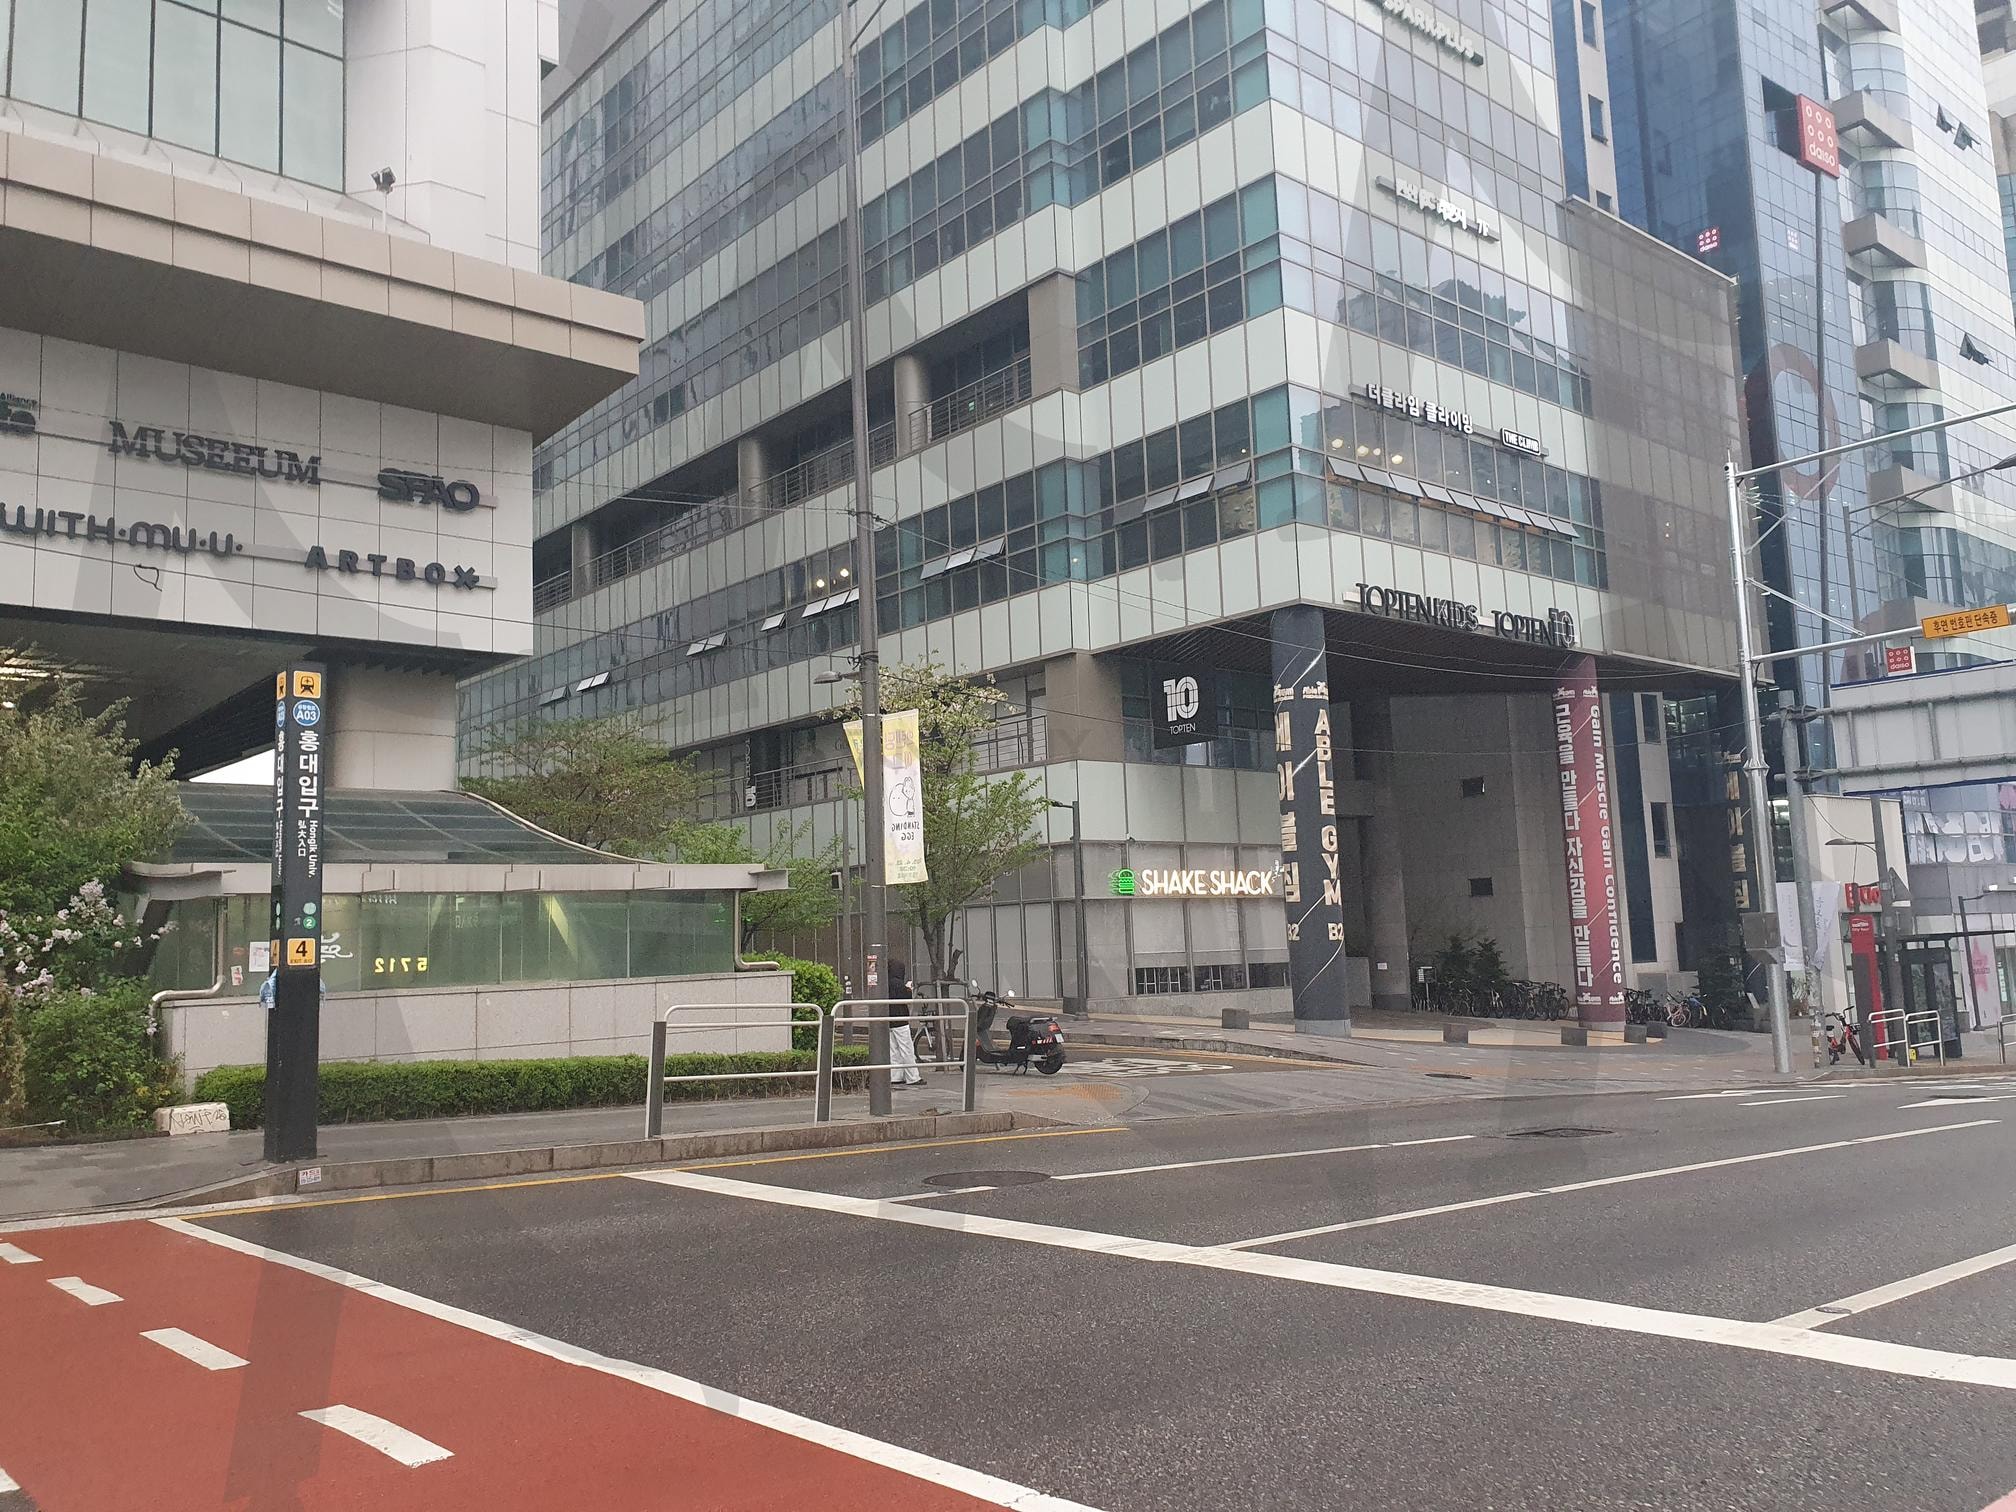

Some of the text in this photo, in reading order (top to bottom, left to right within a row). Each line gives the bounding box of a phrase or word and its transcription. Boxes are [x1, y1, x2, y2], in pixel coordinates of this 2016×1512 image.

[1809, 141, 1835, 167] daiso
[1367, 383, 1474, 434] 더클라임 클라이밍
[107, 421, 321, 486] MUSEEUM
[1504, 431, 1519, 446] THE
[304, 545, 480, 591] ARTBOX
[1933, 610, 1998, 633] 후면 번호판 단속중
[1890, 662, 1910, 670] daiso
[296, 711, 317, 721] A03
[1163, 676, 1199, 722] 10
[1169, 723, 1196, 735] TOPTEN
[1555, 703, 1575, 765] 근육을
[298, 730, 320, 818] 홍대입구
[1561, 769, 1581, 831] 만들다
[298, 820, 307, 857] 弘大入口
[307, 820, 318, 878] Hongik Univ.
[1141, 869, 1273, 896] SHAKE SHACK
[1320, 824, 1342, 906] GYM
[1566, 836, 1588, 919] 자신감을
[305, 919, 313, 927] 2
[1327, 923, 1344, 941] B2
[1604, 874, 1622, 984] Confidence
[295, 940, 308, 957] 4
[1573, 924, 1594, 987] 만들다
